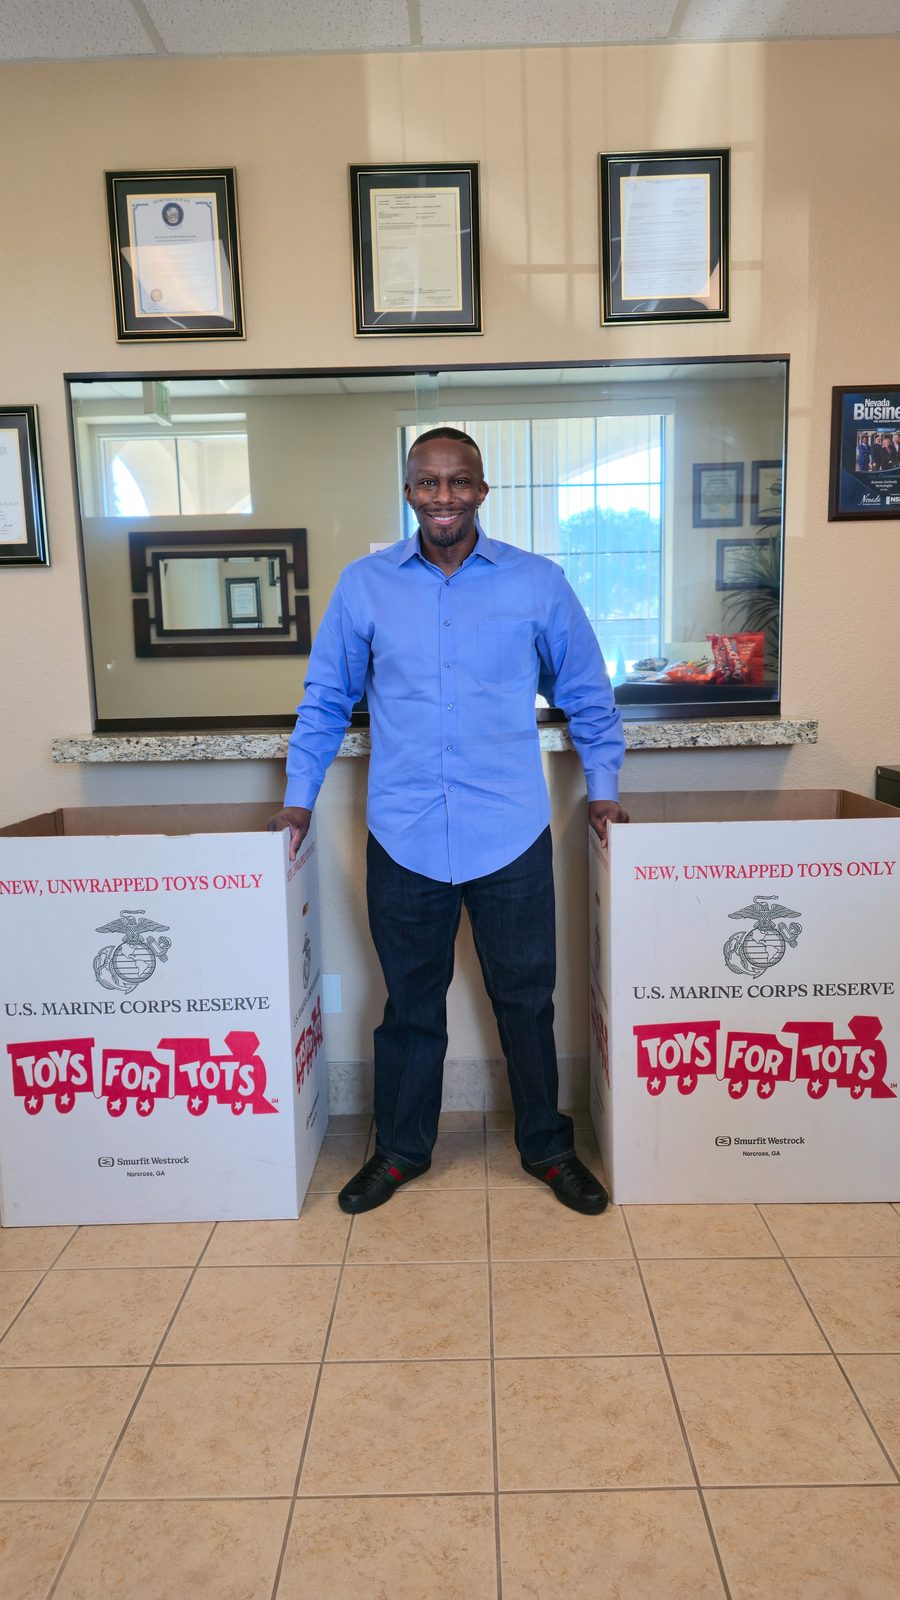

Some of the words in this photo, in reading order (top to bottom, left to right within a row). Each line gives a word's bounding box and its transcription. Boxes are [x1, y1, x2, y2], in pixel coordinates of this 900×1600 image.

[864, 398, 890, 407] Nevada
[858, 493, 881, 506] Nevada
[634, 865, 679, 882] NEW,
[683, 863, 794, 880] UNWRAPPED
[797, 862, 843, 878] TOYS
[847, 861, 896, 877] ONLY
[0, 879, 43, 896] NEW,
[47, 877, 159, 894] UNWRAPPED
[162, 875, 209, 891] TOYS
[213, 874, 263, 889] ONLY
[632, 986, 665, 1000] U.S.
[670, 985, 743, 999] MARINE
[747, 984, 808, 998] CORPS
[812, 982, 895, 997] RESERVE
[4, 1002, 37, 1016] U.S.
[42, 1001, 116, 1016] MARINE
[120, 1000, 182, 1014] CORPS
[185, 996, 270, 1013] RESERVE
[641, 1031, 712, 1070] TOYS
[728, 1040, 784, 1076] FOR
[802, 1044, 876, 1080] TOTS
[16, 1049, 88, 1088] TOYS
[105, 1057, 161, 1093] FOR
[179, 1060, 255, 1096] TOTS
[734, 1136, 766, 1145] Smurfit
[767, 1136, 805, 1145] Westrock
[117, 1156, 150, 1166] Smurfit
[151, 1156, 189, 1165] Westrock
